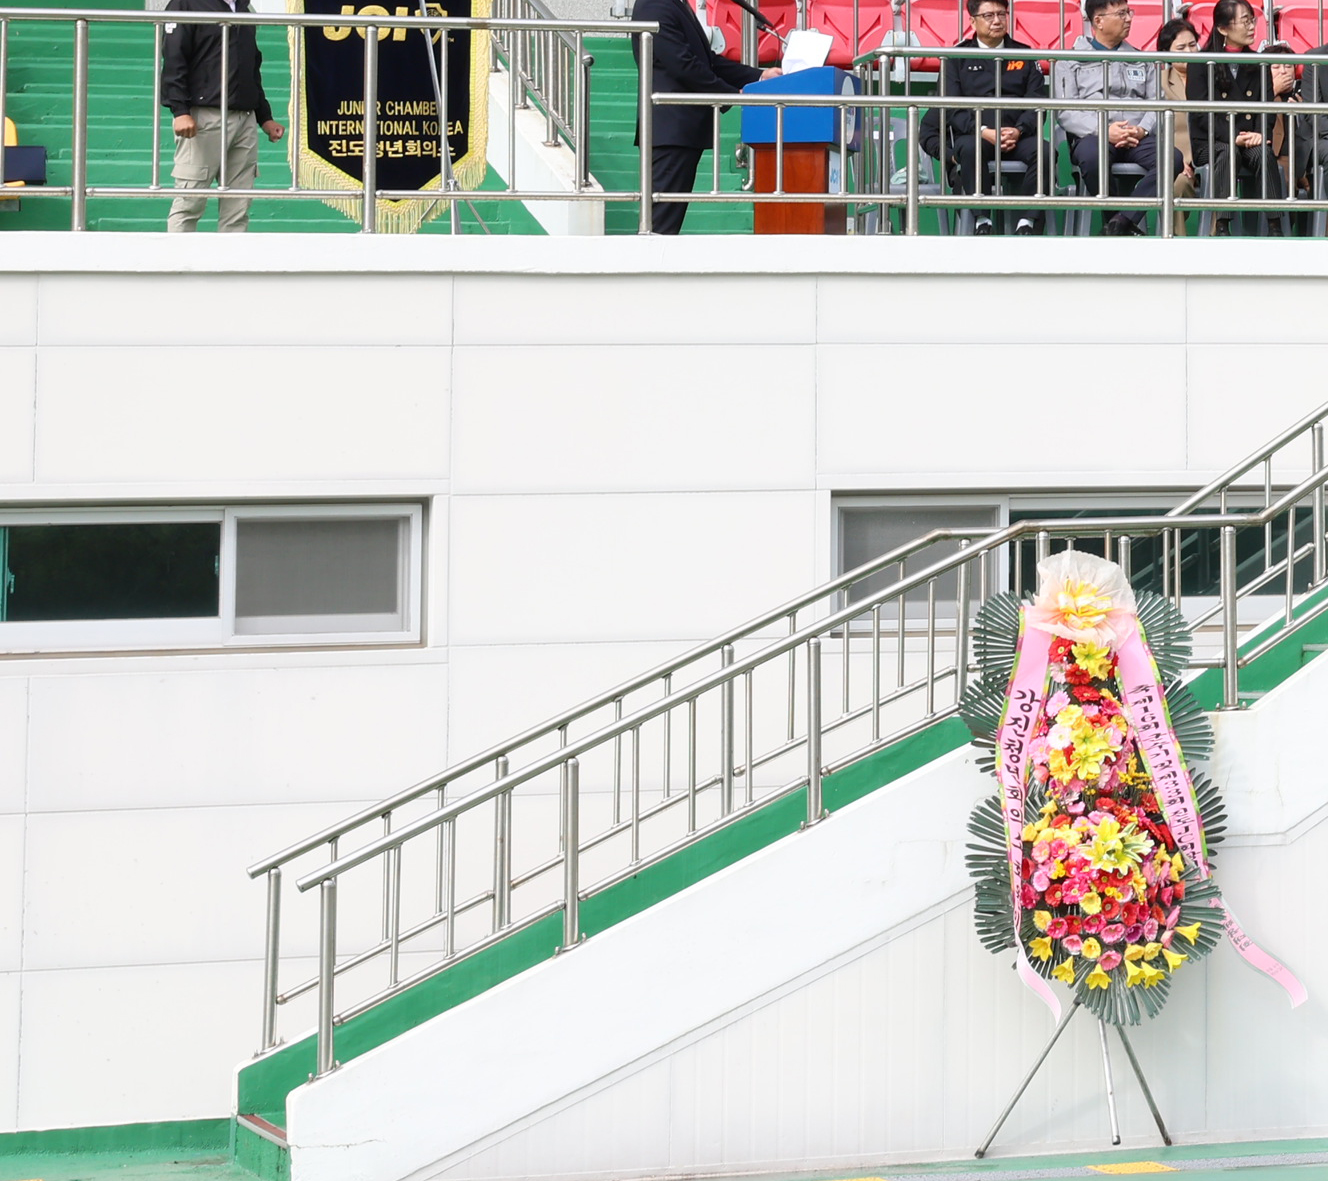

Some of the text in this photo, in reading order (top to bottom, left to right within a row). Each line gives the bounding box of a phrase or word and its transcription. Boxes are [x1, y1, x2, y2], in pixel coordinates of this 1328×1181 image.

[323, 5, 408, 41] JCI
[337, 101, 440, 115] JUNIR CHAMBE
[317, 120, 463, 136] INTERNIONAL KOEA
